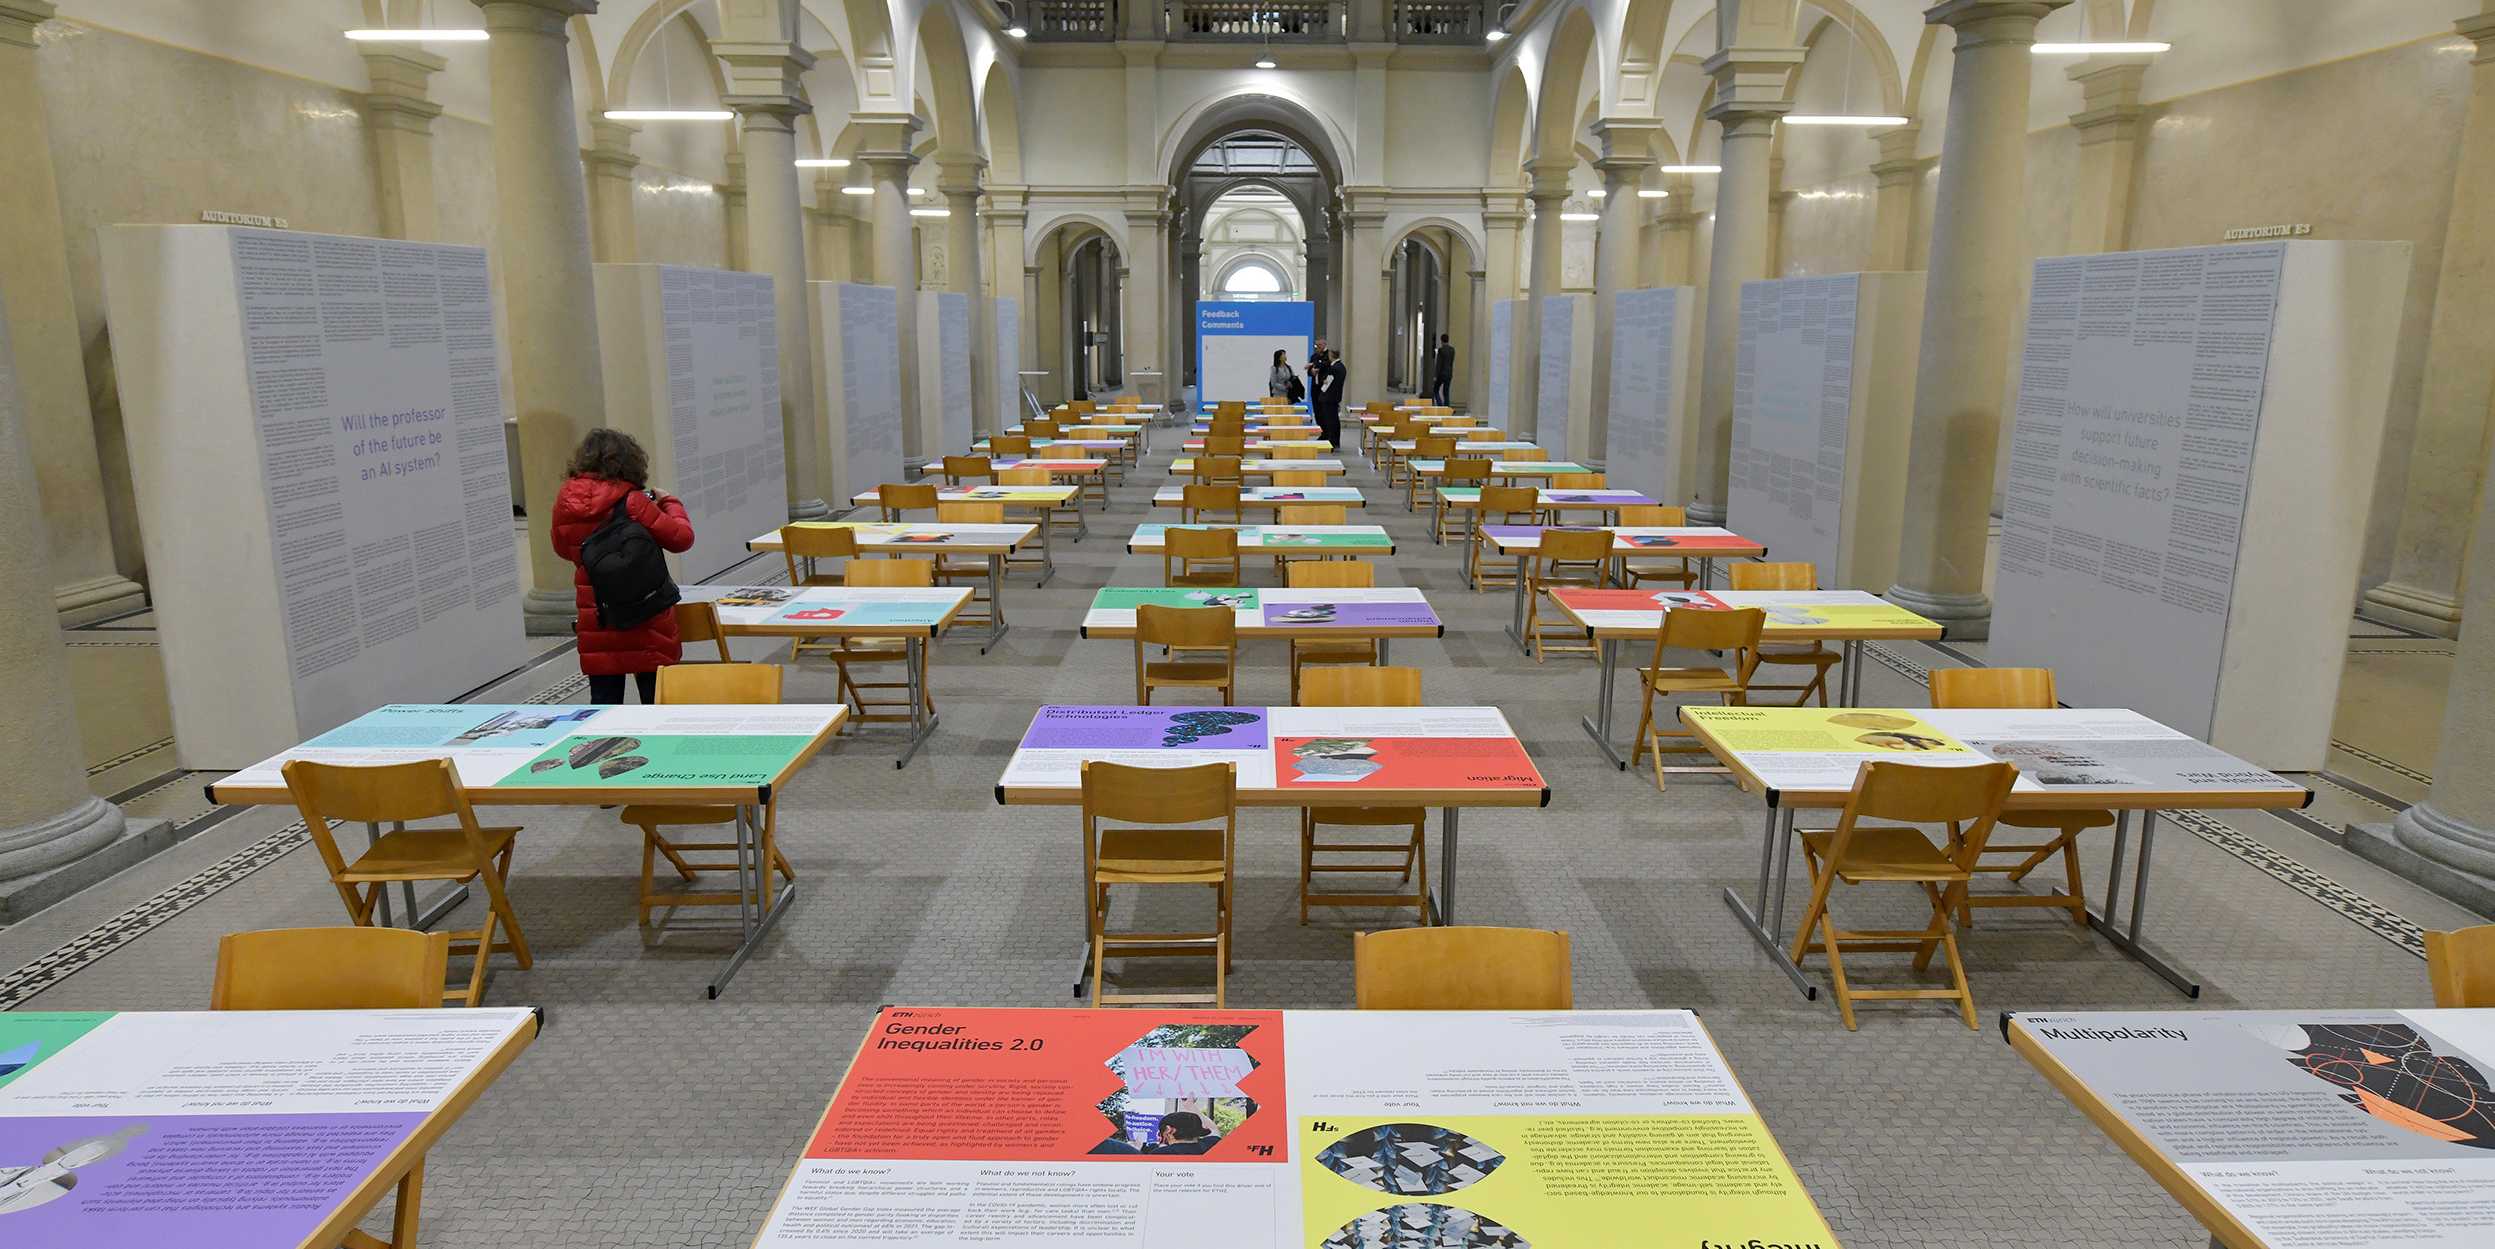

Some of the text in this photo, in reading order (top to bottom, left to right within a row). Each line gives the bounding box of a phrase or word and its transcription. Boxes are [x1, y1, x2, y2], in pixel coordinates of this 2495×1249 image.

[202, 211, 272, 227] AUDITORIUM
[2224, 224, 2311, 240] AUDITORIUM E3
[1201, 310, 1240, 318] Feedback
[1201, 320, 1244, 329] Comments
[341, 408, 446, 432] Will the professor
[2092, 406, 2111, 421] will
[2112, 406, 2182, 430] universities
[353, 430, 442, 457] of the future be
[2080, 426, 2160, 451] support future
[361, 451, 441, 481] an AI system?
[2071, 446, 2162, 481] decision-making
[2060, 470, 2171, 503] with scientific facts?
[1046, 708, 1165, 717] Distributed Ledger
[1694, 709, 1767, 717] Intellectual
[642, 772, 768, 780] Land Use Change
[1466, 775, 1533, 784] Migration
[884, 1022, 967, 1035] Gender
[2039, 1026, 2188, 1042] Multipolarity
[876, 1037, 1045, 1053] Inequalities 2.0
[1171, 1048, 1224, 1061] WITH
[1184, 1065, 1243, 1081] THEM
[810, 1167, 833, 1175] What
[835, 1167, 846, 1175] do
[862, 1167, 892, 1175] know?
[979, 1169, 1002, 1177] What
[1003, 1169, 1015, 1177] do
[1047, 1169, 1076, 1177] know?
